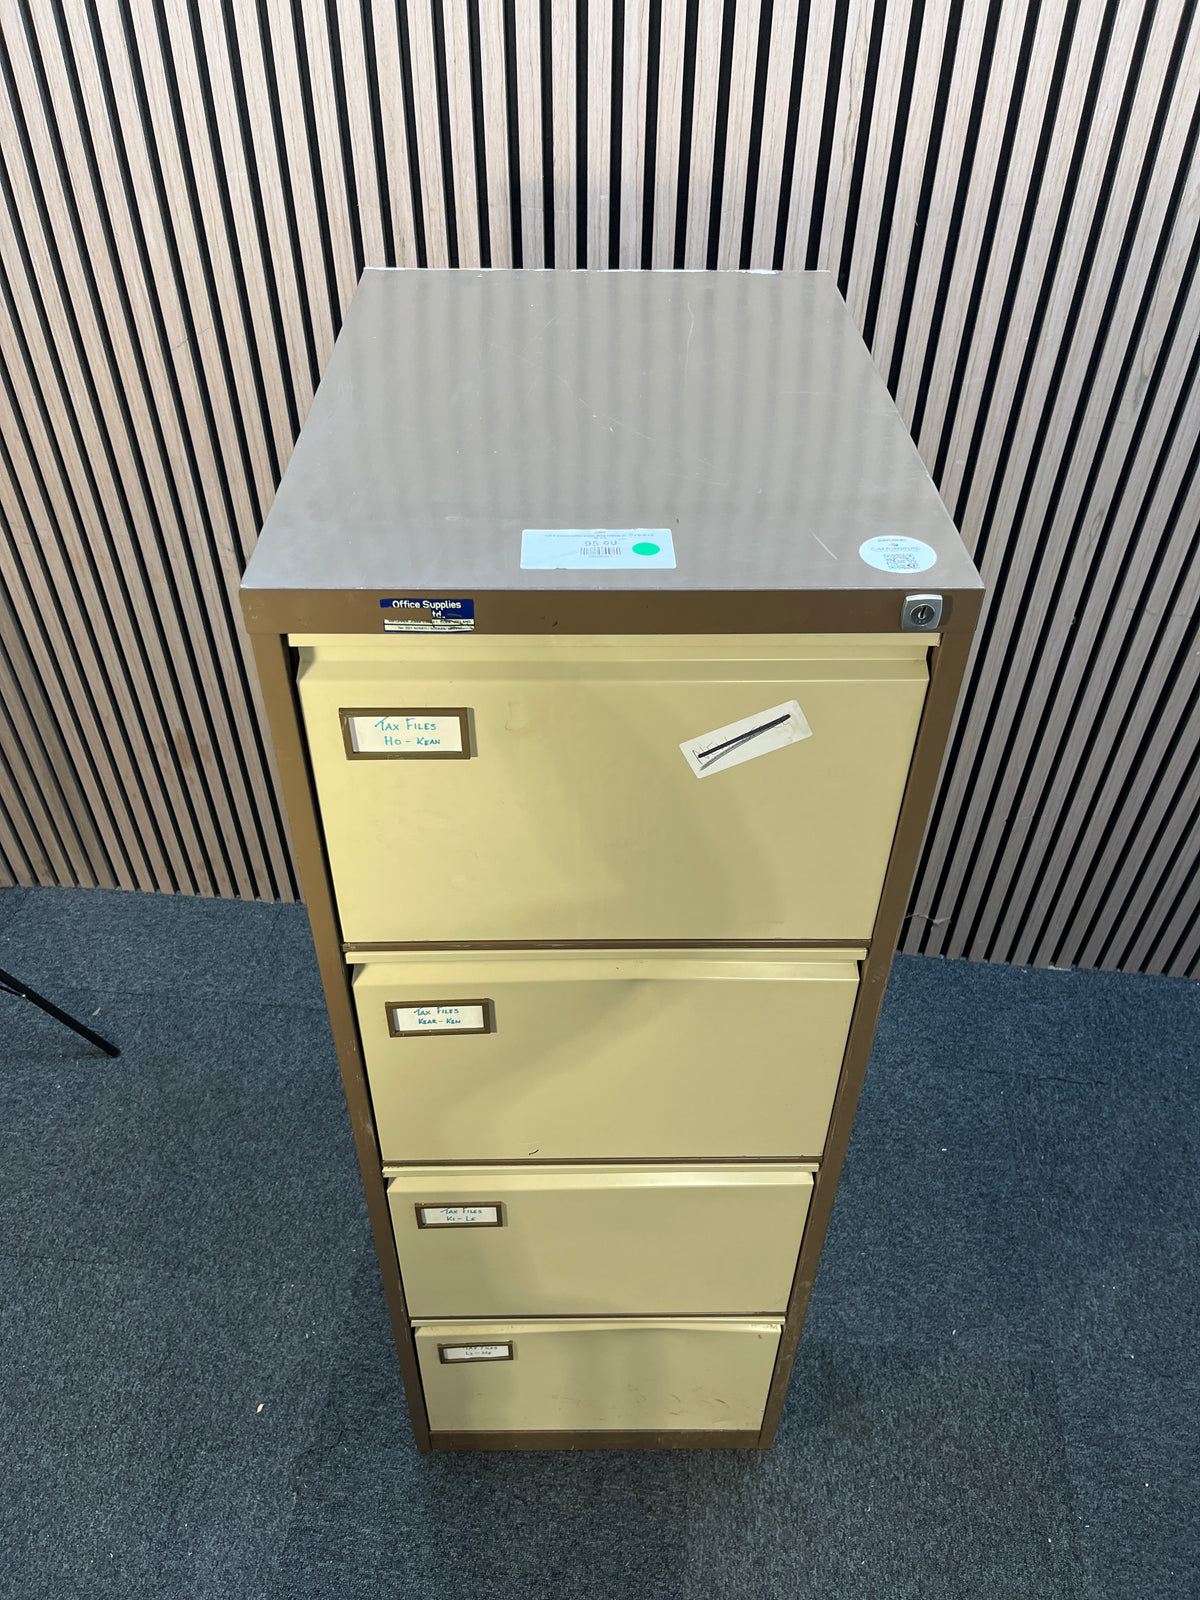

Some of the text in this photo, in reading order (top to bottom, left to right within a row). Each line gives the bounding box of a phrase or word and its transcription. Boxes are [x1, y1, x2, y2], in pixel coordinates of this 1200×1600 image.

[392, 600, 462, 611] Office Supplies
[374, 717, 437, 731] TAX FILES
[416, 737, 441, 746] KEAN
[413, 1007, 431, 1016] TAX
